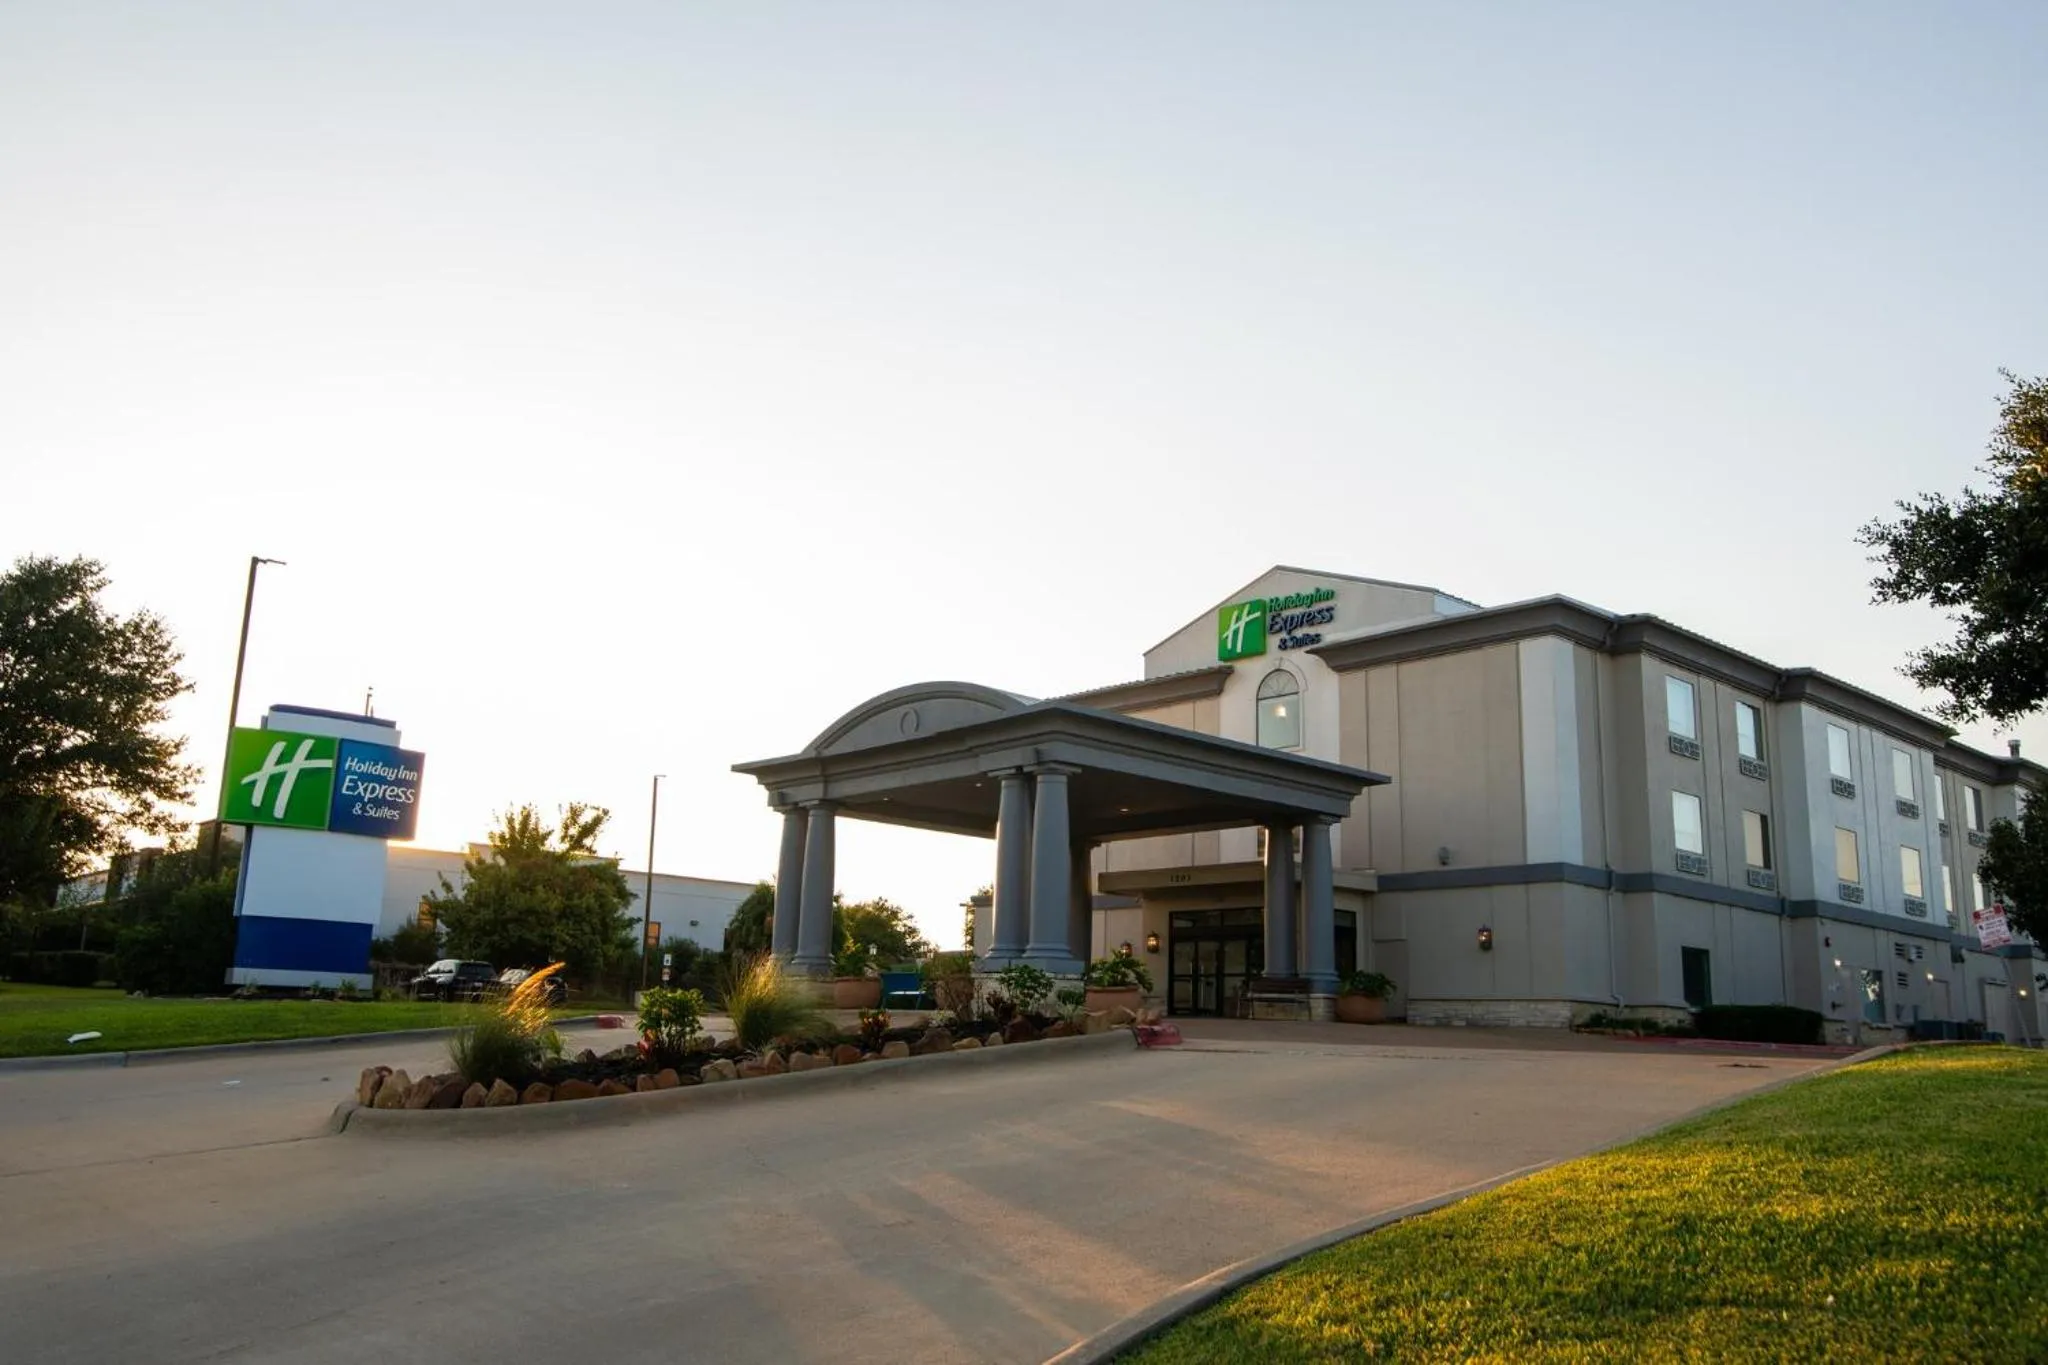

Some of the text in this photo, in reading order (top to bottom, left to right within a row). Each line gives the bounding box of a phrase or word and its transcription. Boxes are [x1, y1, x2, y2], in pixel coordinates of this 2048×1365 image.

[1269, 588, 1334, 612] Holiday Inn
[1269, 607, 1334, 633] Express
[1278, 633, 1321, 651] & Suites
[345, 757, 418, 781] Holiday Inn
[341, 775, 415, 804] Express
[352, 803, 400, 820] & Suites
